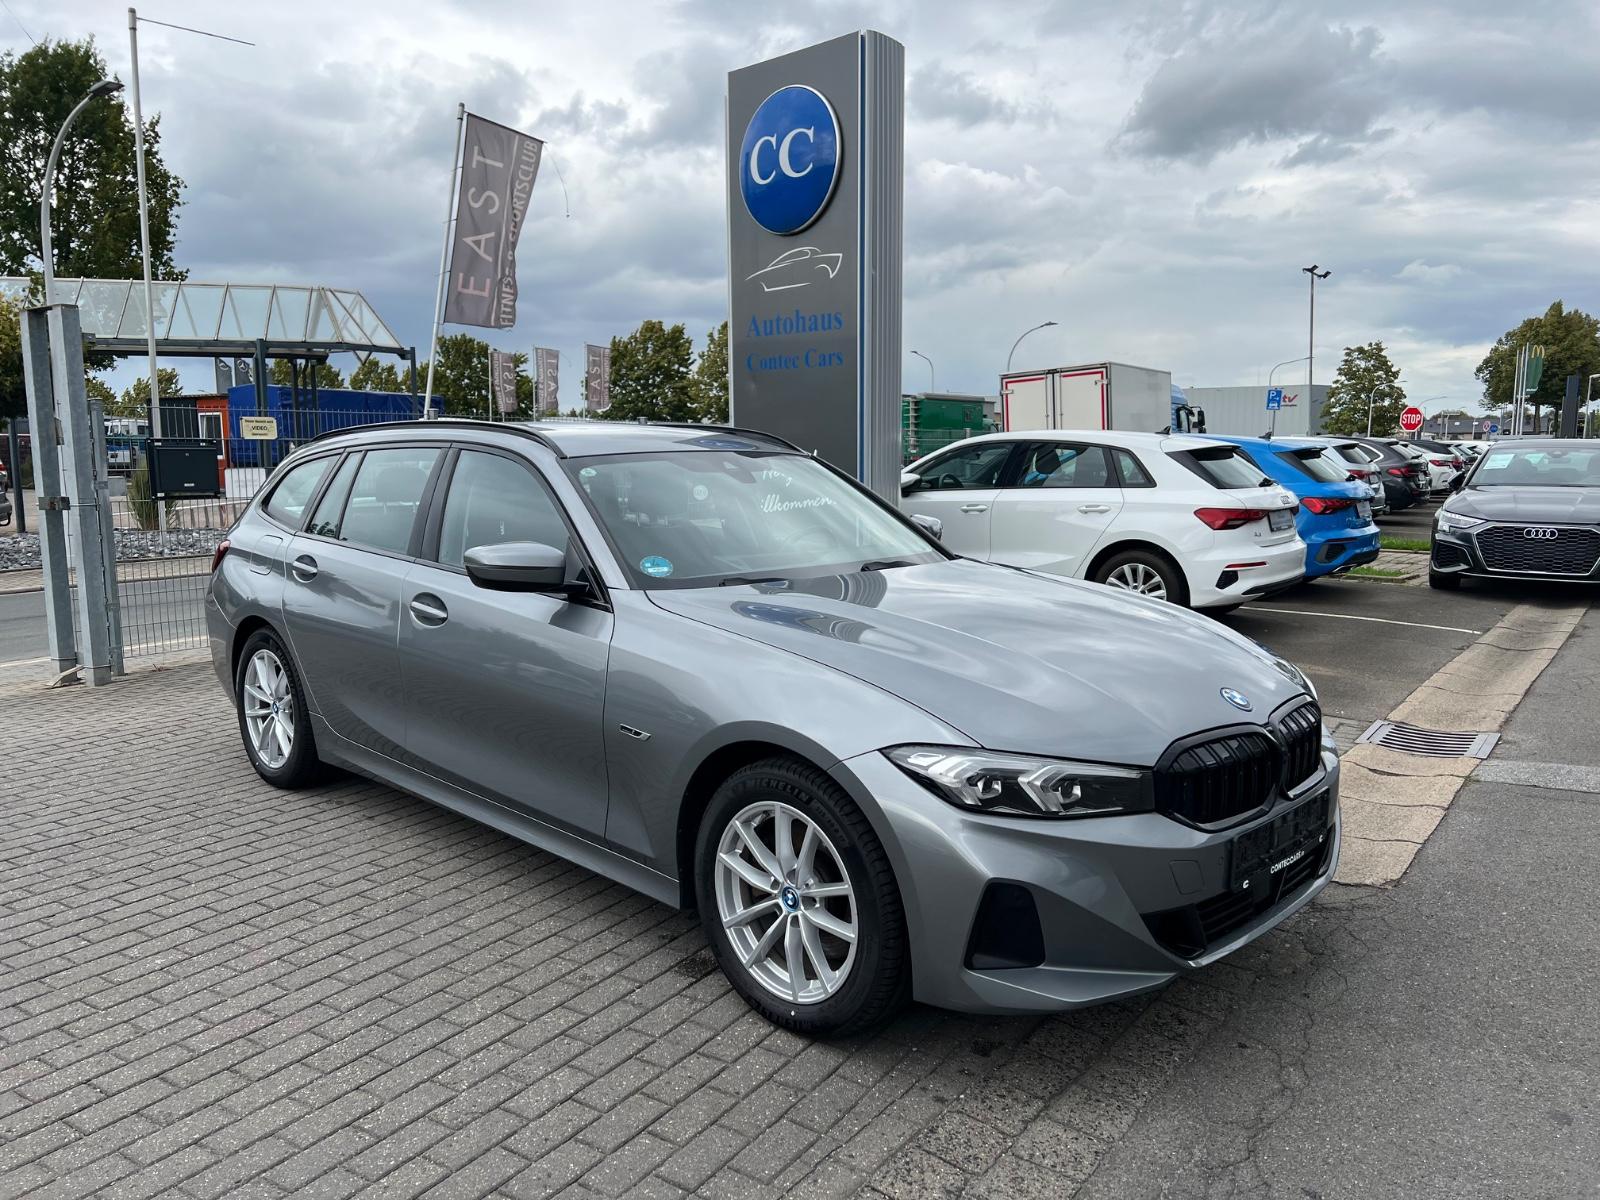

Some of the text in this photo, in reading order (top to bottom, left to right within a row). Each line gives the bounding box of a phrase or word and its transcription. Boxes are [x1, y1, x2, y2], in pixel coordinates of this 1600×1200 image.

[749, 125, 815, 186] CC
[456, 145, 504, 298] EAST
[746, 308, 844, 339] Autohaus
[746, 348, 844, 374] Contec Cars
[589, 354, 601, 401] EAST
[1269, 390, 1277, 400] P
[1402, 413, 1421, 424] STOP
